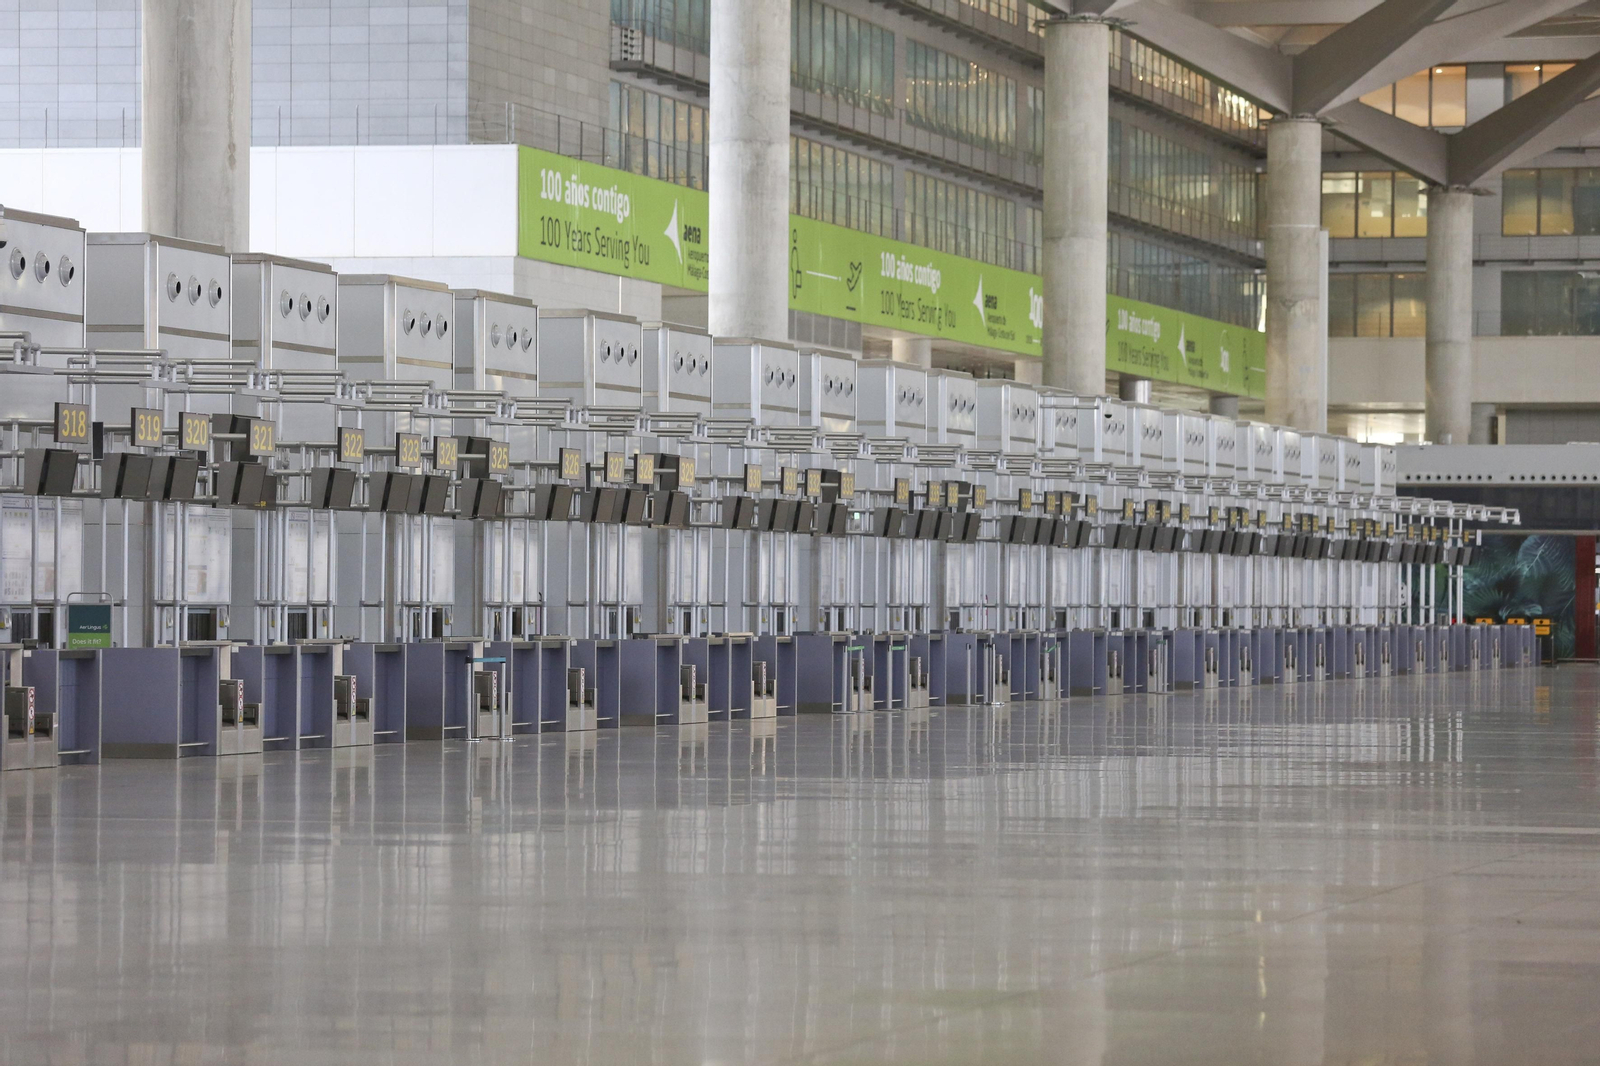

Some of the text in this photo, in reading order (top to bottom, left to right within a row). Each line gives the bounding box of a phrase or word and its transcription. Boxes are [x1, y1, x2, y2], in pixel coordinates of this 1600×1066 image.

[540, 168, 630, 224] 100 años contigo
[540, 215, 650, 269] 100 Years Serving You
[684, 224, 701, 244] aena
[880, 251, 941, 294] 100 años contigo
[880, 290, 895, 316] 100
[896, 292, 916, 321] Years
[917, 296, 942, 332] Serving
[944, 303, 956, 328] You
[62, 410, 86, 438] 318
[138, 414, 160, 442] 319
[186, 418, 208, 446] 320
[252, 424, 273, 452] 321
[344, 432, 362, 458] 322
[402, 438, 420, 462] 323
[440, 442, 456, 465] 324
[492, 446, 508, 470] 325
[564, 454, 580, 476] 326
[608, 457, 624, 478] 327
[638, 459, 654, 480] 328
[681, 462, 695, 482] 329
[748, 468, 761, 488] 330
[784, 472, 796, 491] 331
[808, 474, 820, 493] 332
[842, 477, 854, 496] 333
